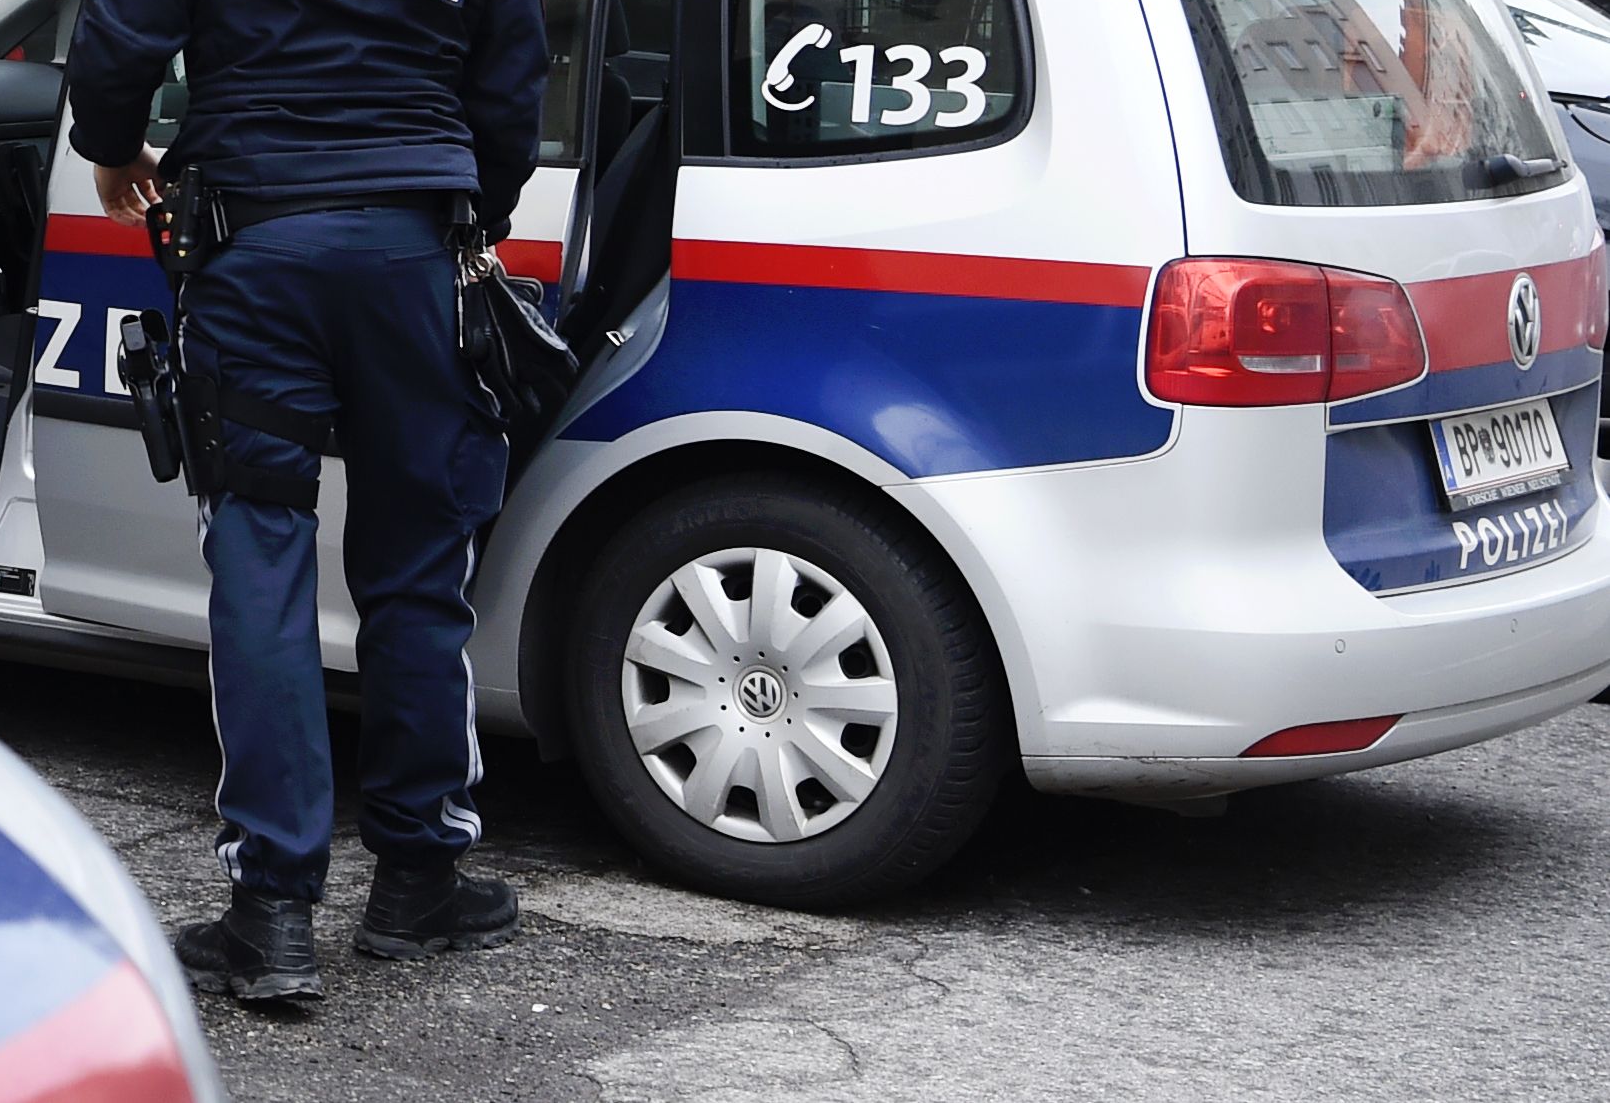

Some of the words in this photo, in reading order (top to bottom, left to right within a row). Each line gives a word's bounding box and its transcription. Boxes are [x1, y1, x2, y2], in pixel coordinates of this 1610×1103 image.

[840, 44, 987, 128] 133
[1453, 424, 1480, 477] BP
[1491, 409, 1552, 468] 90170
[1452, 499, 1567, 569] POLIZEI
